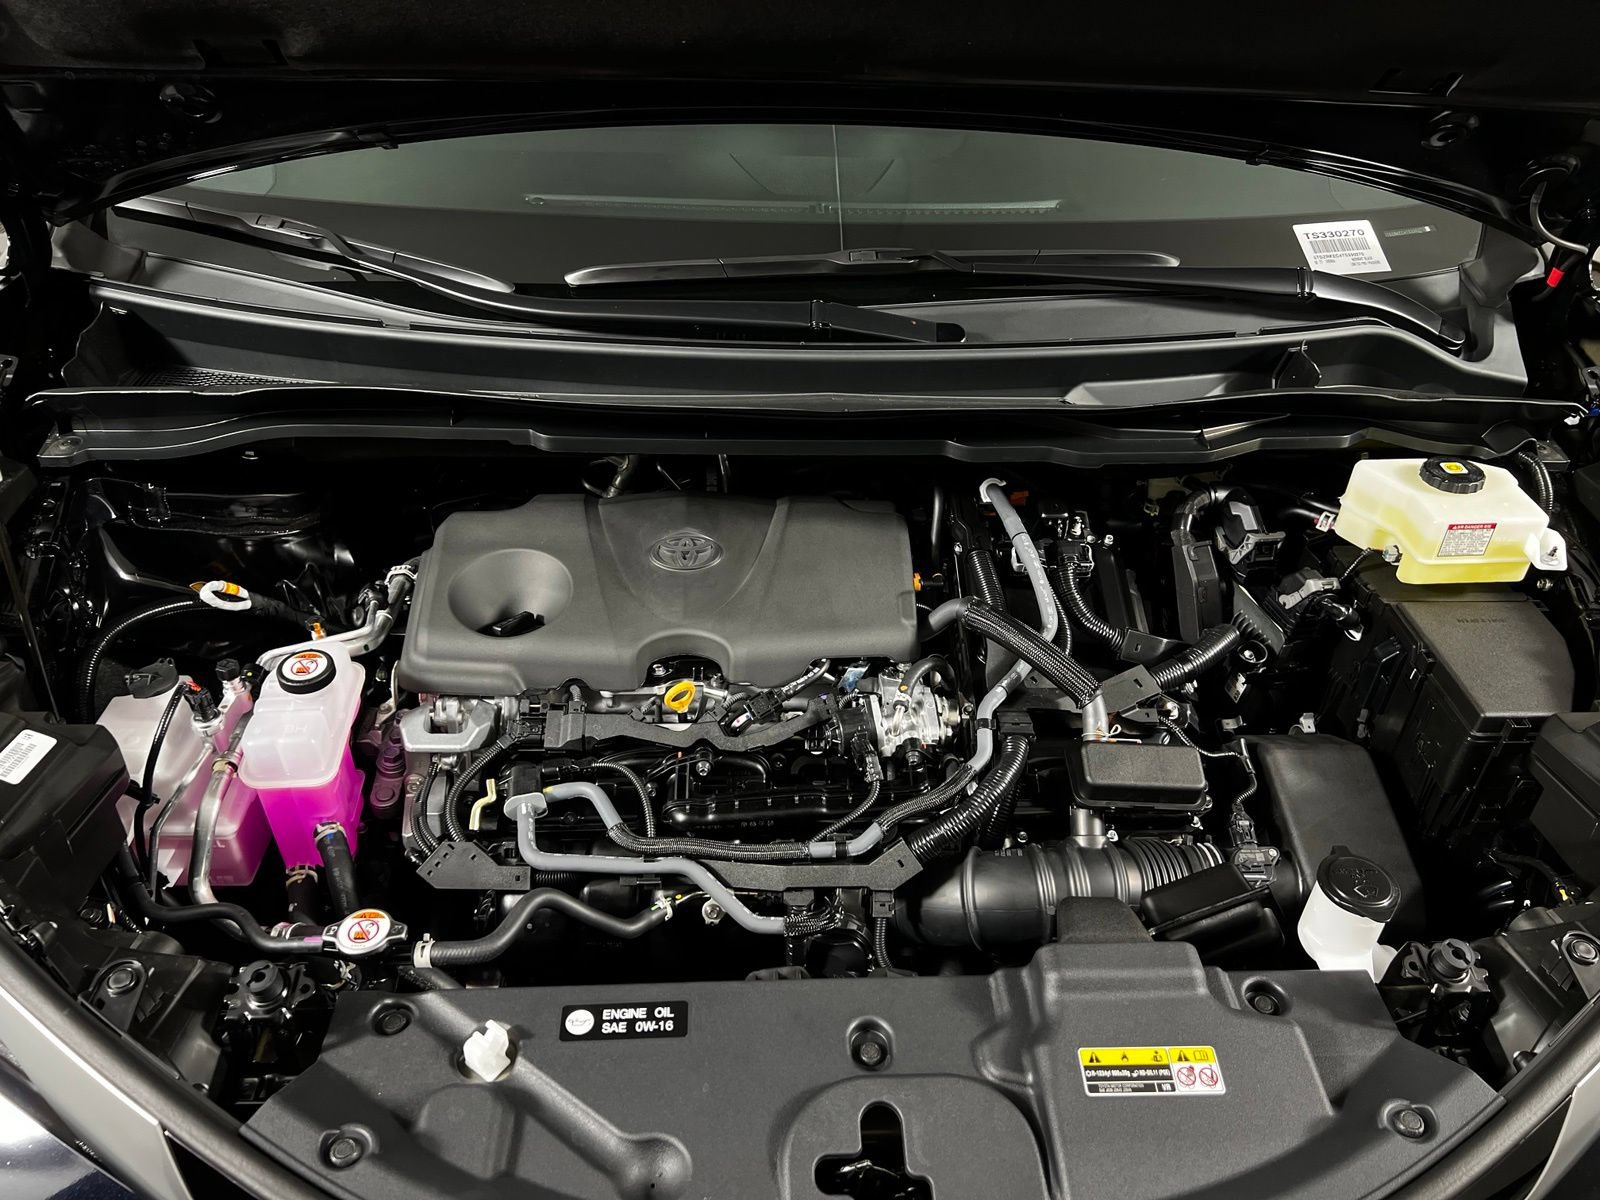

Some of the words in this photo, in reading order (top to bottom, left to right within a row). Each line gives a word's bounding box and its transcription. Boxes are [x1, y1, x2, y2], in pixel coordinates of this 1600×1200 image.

[1303, 229, 1365, 240] TS330270
[602, 1007, 648, 1020] ENGINE
[654, 1006, 675, 1018] OIL
[601, 1022, 628, 1034] SAE
[635, 1020, 674, 1032] 0W-16
